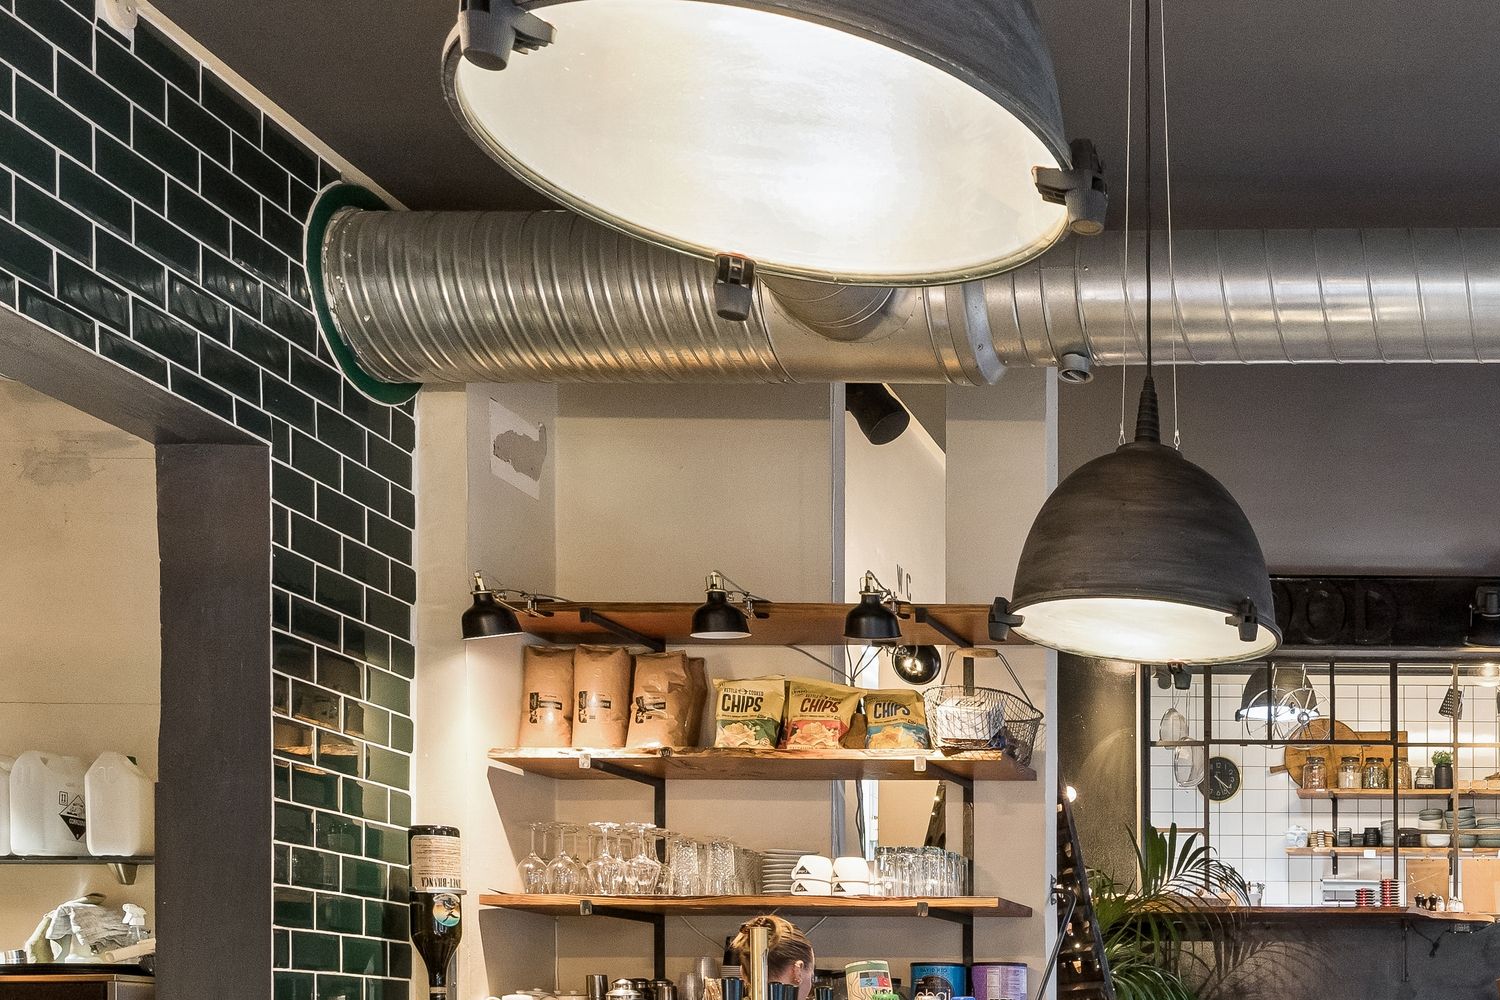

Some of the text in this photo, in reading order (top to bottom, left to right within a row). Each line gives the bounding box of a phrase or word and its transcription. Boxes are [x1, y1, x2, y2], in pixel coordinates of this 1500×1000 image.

[722, 694, 763, 712] CHIPS
[800, 698, 842, 713] CHIPS
[874, 701, 910, 718] CHIPS
